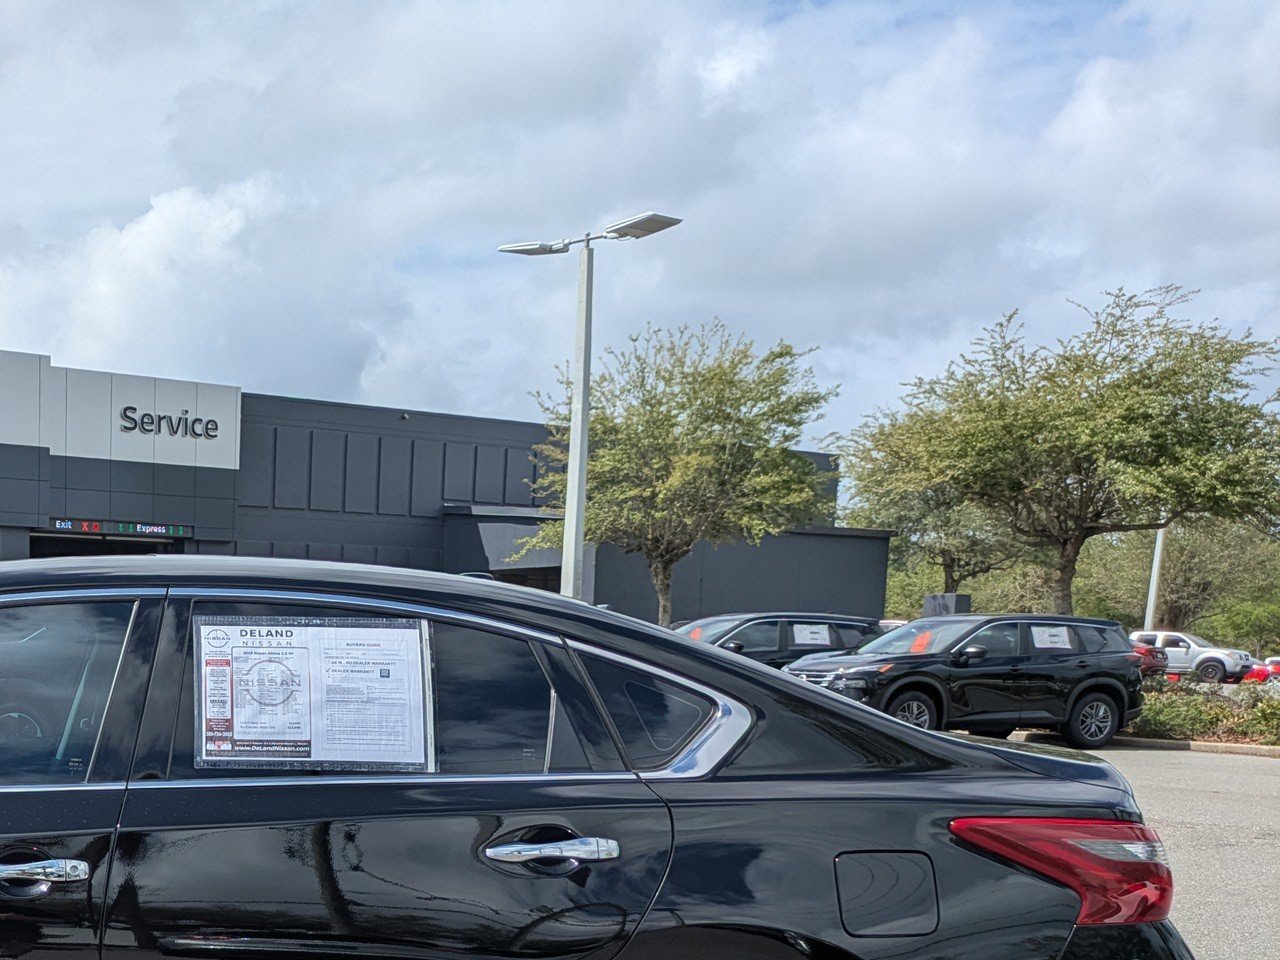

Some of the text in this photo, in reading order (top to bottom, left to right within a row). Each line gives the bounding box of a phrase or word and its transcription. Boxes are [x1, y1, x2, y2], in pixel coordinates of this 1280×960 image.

[121, 406, 219, 439] Service
[55, 520, 72, 530] Exit
[136, 524, 166, 534] Express
[239, 629, 294, 638] DELAND
[238, 678, 302, 687] NISSAN
